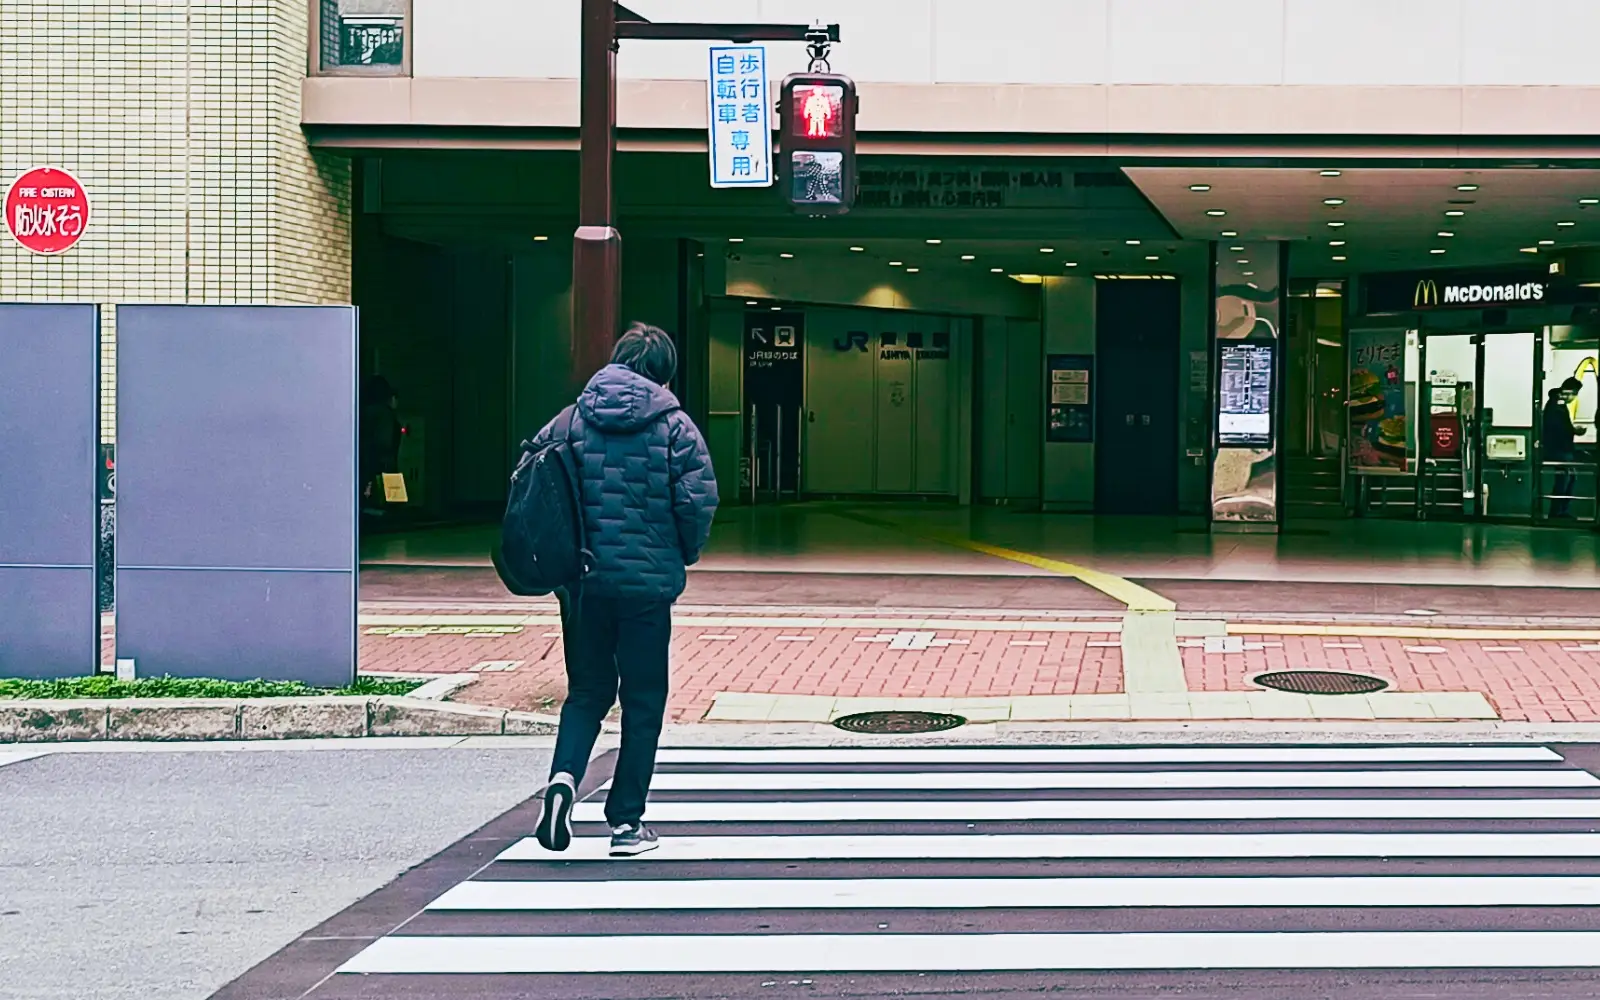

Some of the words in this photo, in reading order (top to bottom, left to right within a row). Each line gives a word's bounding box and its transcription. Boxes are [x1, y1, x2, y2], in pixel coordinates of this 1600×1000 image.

[717, 54, 738, 125] 自転車
[740, 54, 760, 123] 歩行者
[731, 130, 751, 176] 専用
[19, 187, 37, 198] FIRE
[41, 187, 76, 198] CISTERN
[15, 203, 82, 236] 防火水そう
[1444, 283, 1544, 303] McDonald's
[833, 331, 869, 352] JR
